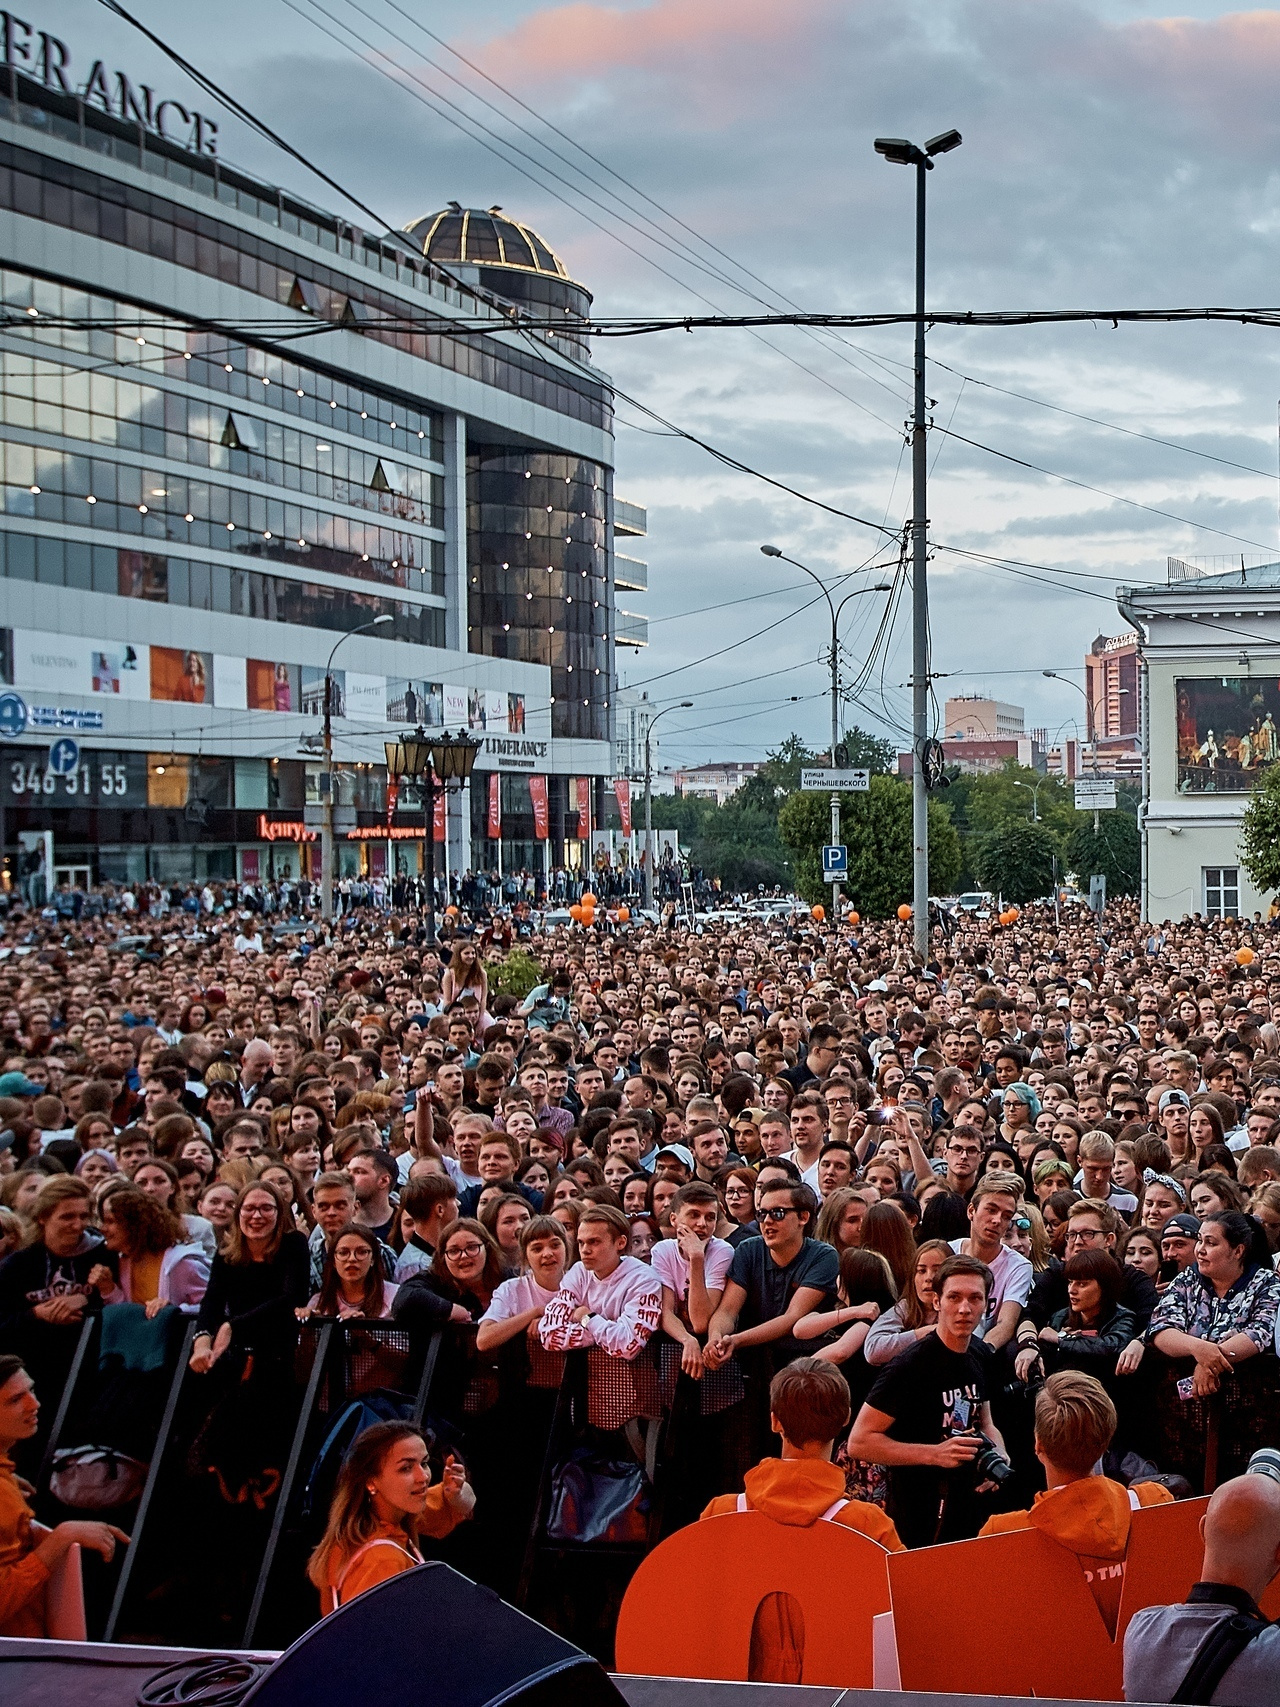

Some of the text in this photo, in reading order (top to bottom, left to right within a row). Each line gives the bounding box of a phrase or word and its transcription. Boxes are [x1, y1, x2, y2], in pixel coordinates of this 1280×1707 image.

[485, 738, 548, 758] LIMERANCE
[11, 761, 56, 795] 346
[101, 764, 127, 795] 55
